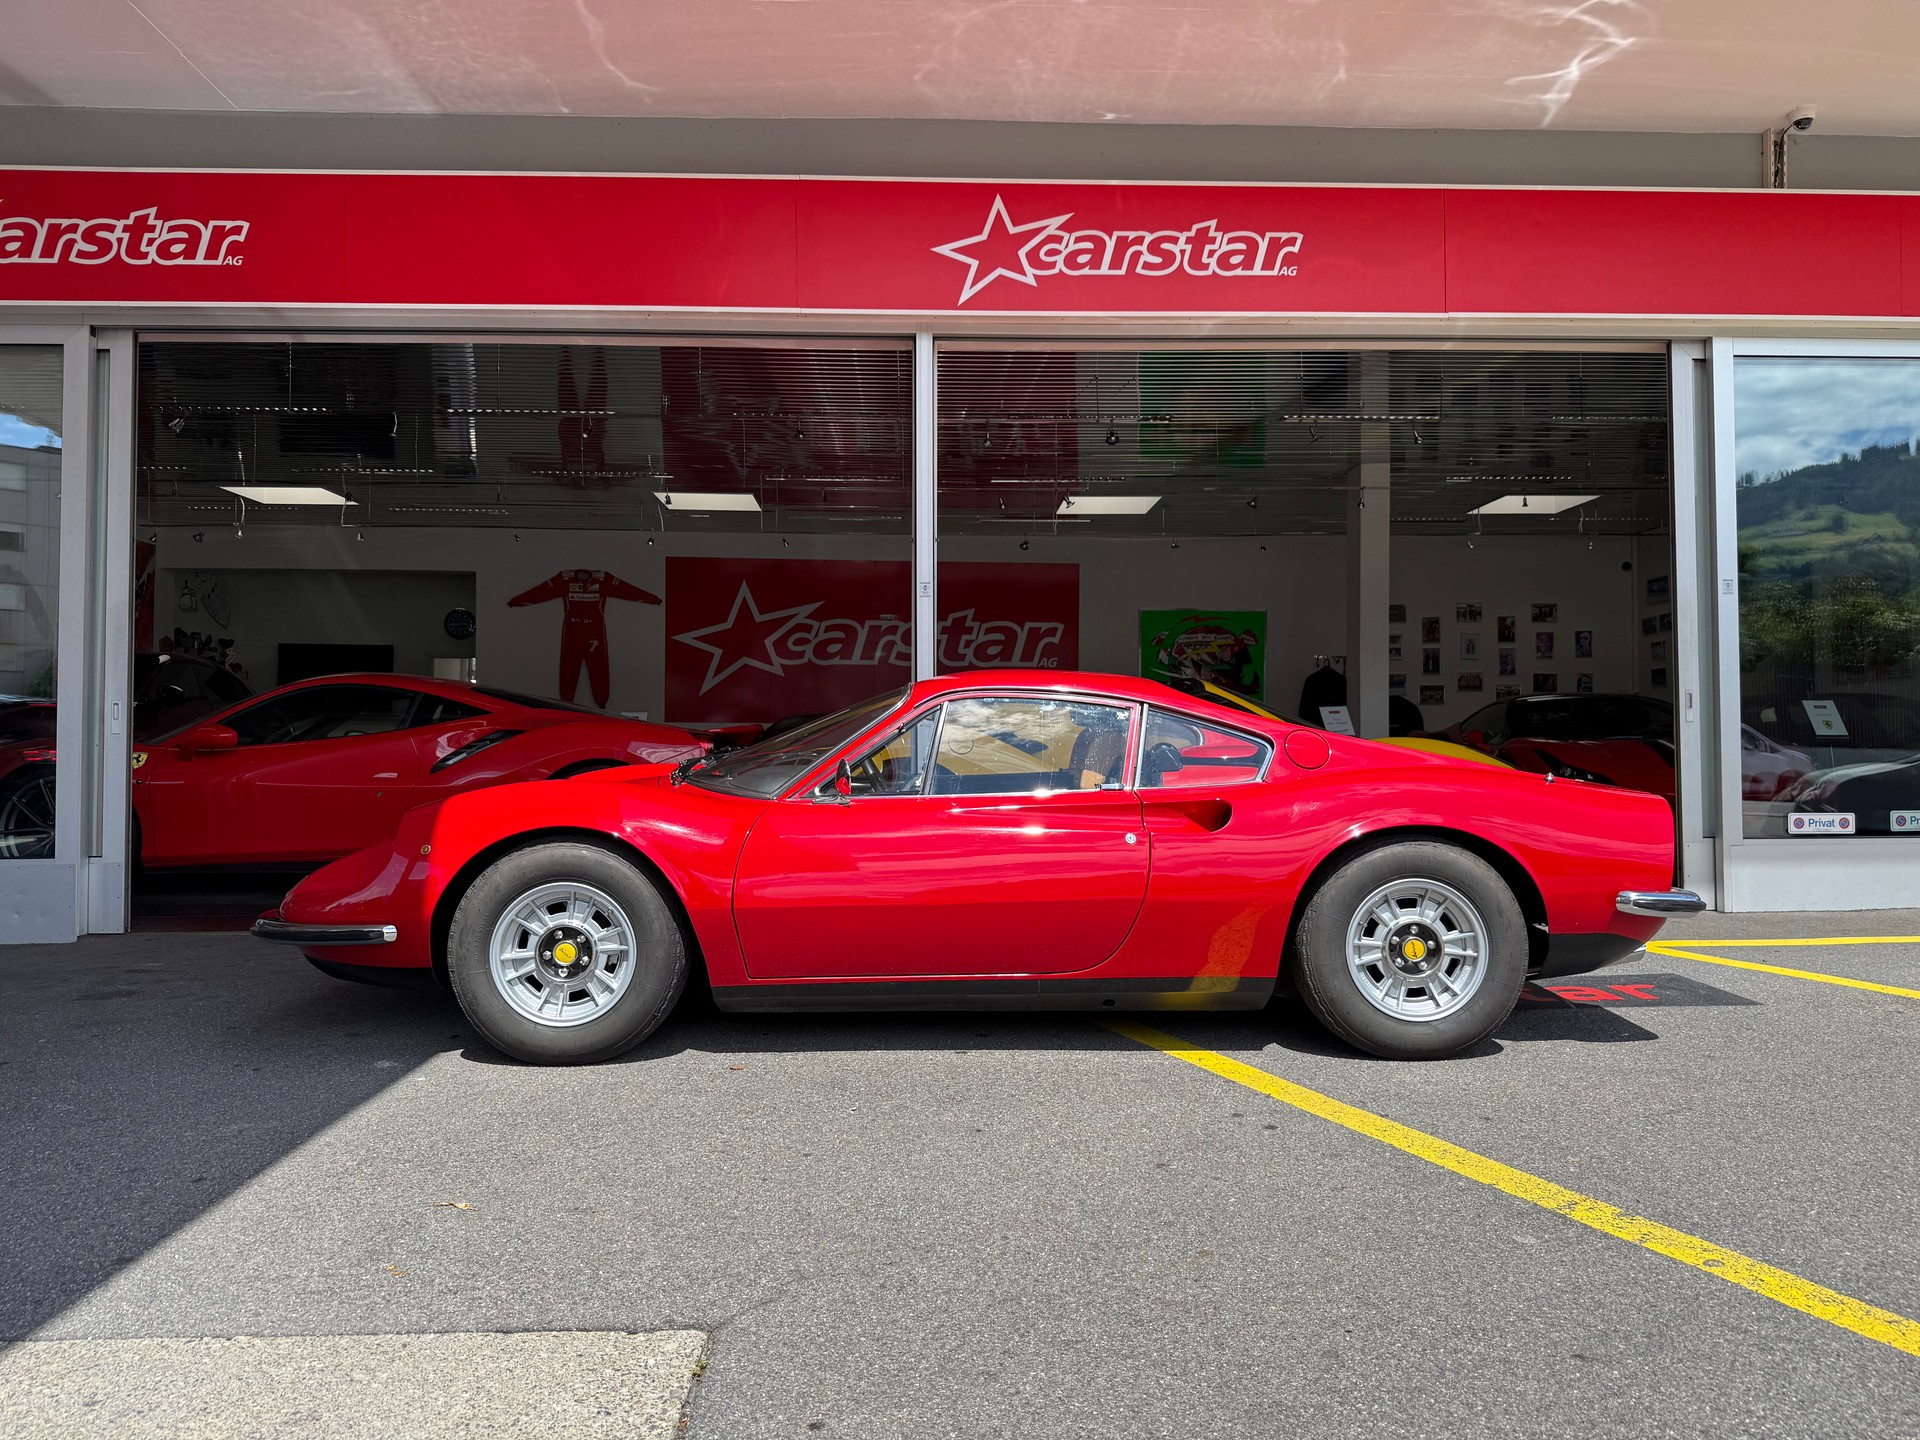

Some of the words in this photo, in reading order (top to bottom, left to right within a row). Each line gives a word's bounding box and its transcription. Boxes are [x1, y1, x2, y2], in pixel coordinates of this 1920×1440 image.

[0, 207, 250, 265] arstar
[223, 255, 243, 266] AG
[1020, 219, 1304, 276] carstar
[1279, 266, 1298, 277] AG
[1038, 657, 1058, 668] AG
[1808, 818, 1835, 828] Privat
[1910, 816, 1920, 826] Pr
